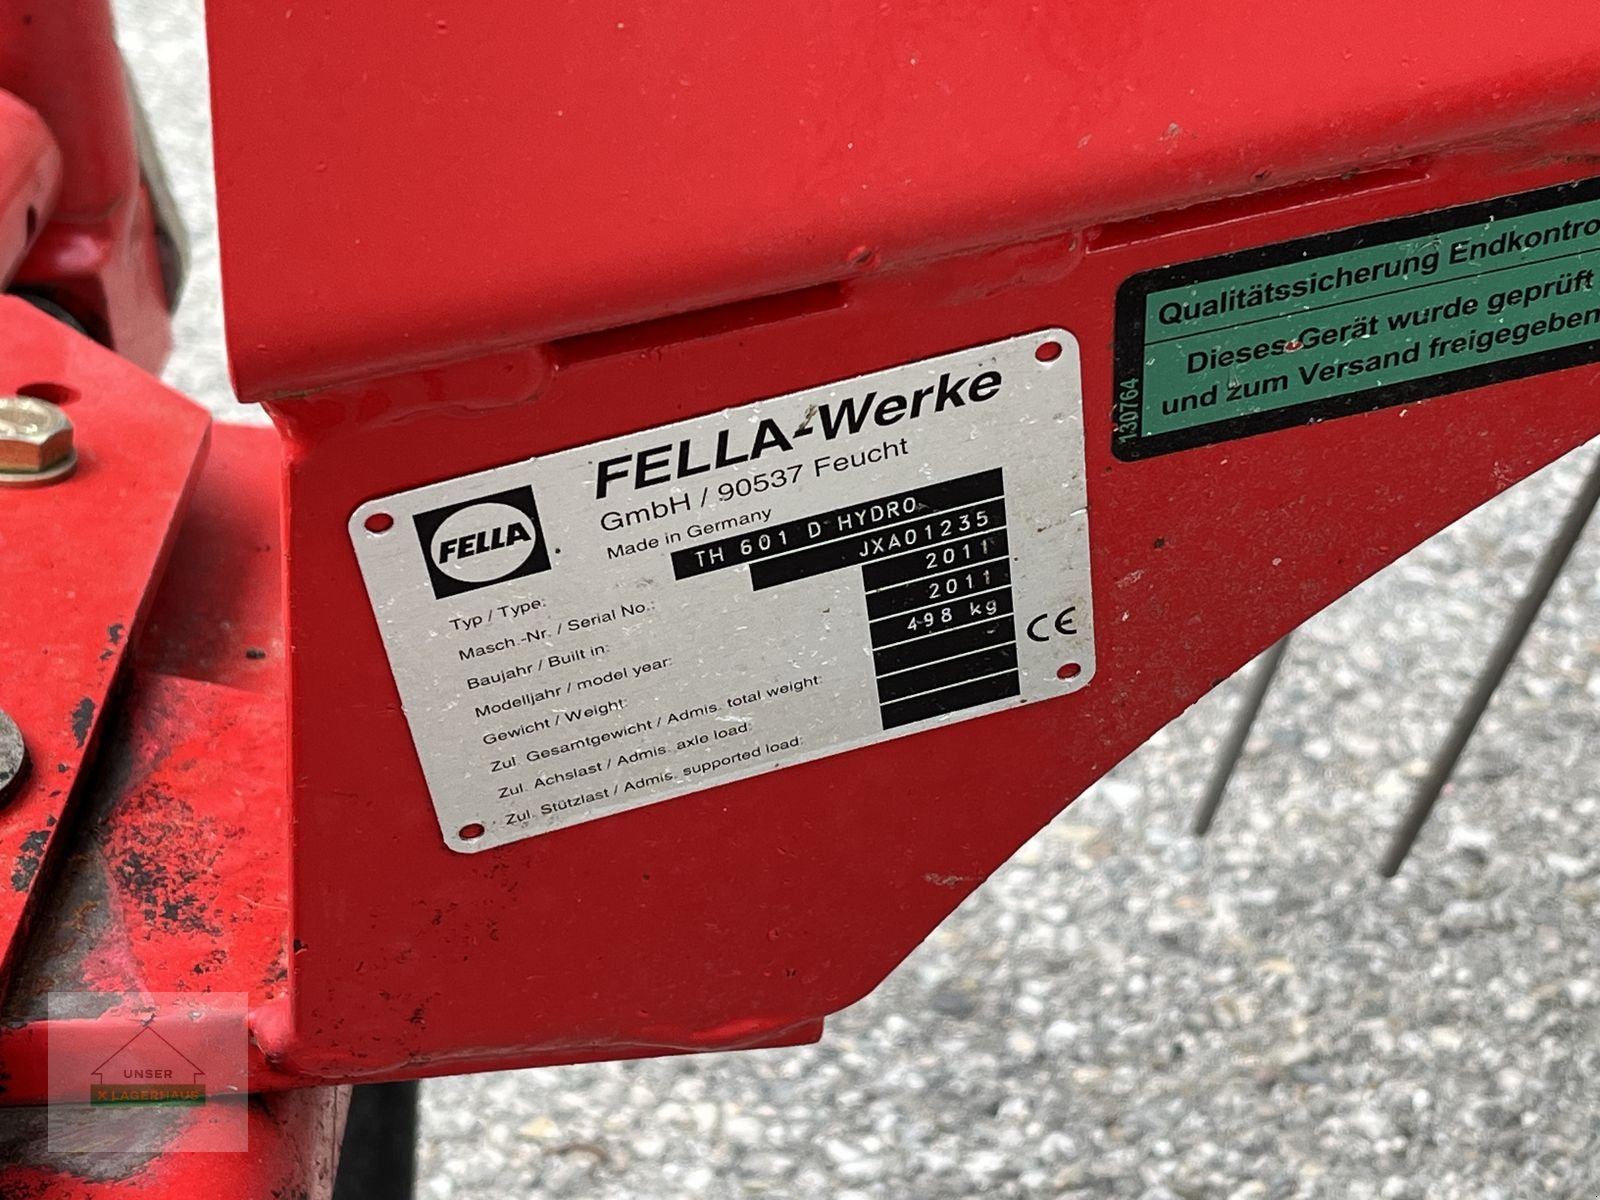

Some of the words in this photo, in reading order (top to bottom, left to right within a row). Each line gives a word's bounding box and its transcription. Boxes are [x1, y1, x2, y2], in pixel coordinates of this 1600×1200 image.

[1158, 246, 1440, 327] Qualitätssicherung
[1187, 339, 1287, 375] Dieses
[1298, 317, 1378, 350] Gerät
[1388, 295, 1478, 332] wurde
[1487, 268, 1594, 316] geprüft
[1161, 385, 1218, 417] und
[1226, 374, 1290, 402] zum
[1299, 341, 1420, 386] Versand
[1428, 308, 1600, 360] freigegeben
[596, 370, 1002, 499] FELLA-Werke
[1118, 378, 1139, 443] 130764
[600, 493, 691, 531] GmbH
[700, 487, 708, 508] /
[718, 465, 803, 501] 90537
[814, 438, 908, 477] Feucht
[438, 522, 531, 565] FELLA
[607, 538, 659, 559] Made
[665, 531, 681, 544] in
[687, 508, 772, 538] Germany
[695, 546, 725, 567] TH
[740, 529, 788, 555] 601
[807, 520, 822, 539] D
[837, 496, 917, 532] HYDRO
[859, 510, 989, 557] JXA01235
[925, 538, 989, 569] 2011
[449, 615, 483, 631] Typ
[487, 609, 493, 622] /
[497, 598, 547, 618] Type:
[929, 569, 991, 599] 2011
[458, 628, 552, 661] Masch.-Nr.
[556, 622, 563, 635] /
[567, 609, 617, 631] Serial
[621, 601, 655, 618] No.:
[907, 607, 953, 631] 498
[969, 600, 998, 616] kg
[467, 664, 533, 690] Baujahr
[537, 659, 543, 671] /
[548, 650, 586, 668] Built
[590, 643, 610, 657] in:
[474, 686, 561, 718] Modelljahr
[566, 682, 572, 693] /
[577, 667, 628, 690] model
[633, 657, 673, 678] year:
[482, 718, 551, 746] Gewicht
[554, 714, 560, 726] /
[564, 698, 628, 723] Weight:
[490, 756, 520, 773] Zul.
[526, 719, 652, 763] Gesamtgewicht
[656, 716, 662, 728] /
[667, 703, 722, 725] Admis.
[727, 690, 761, 708] total
[766, 675, 823, 698] weight:
[498, 783, 528, 799] Zul.
[534, 762, 602, 790] Achslast
[606, 759, 612, 770] /
[617, 745, 671, 766] Admis.
[676, 733, 709, 751] axle
[713, 722, 752, 740] load:
[505, 809, 536, 826] Zul.
[540, 787, 610, 816] Stützlast
[613, 784, 619, 796] /
[624, 771, 678, 793] Admis.
[683, 747, 762, 776] supported
[765, 736, 804, 754] load:
